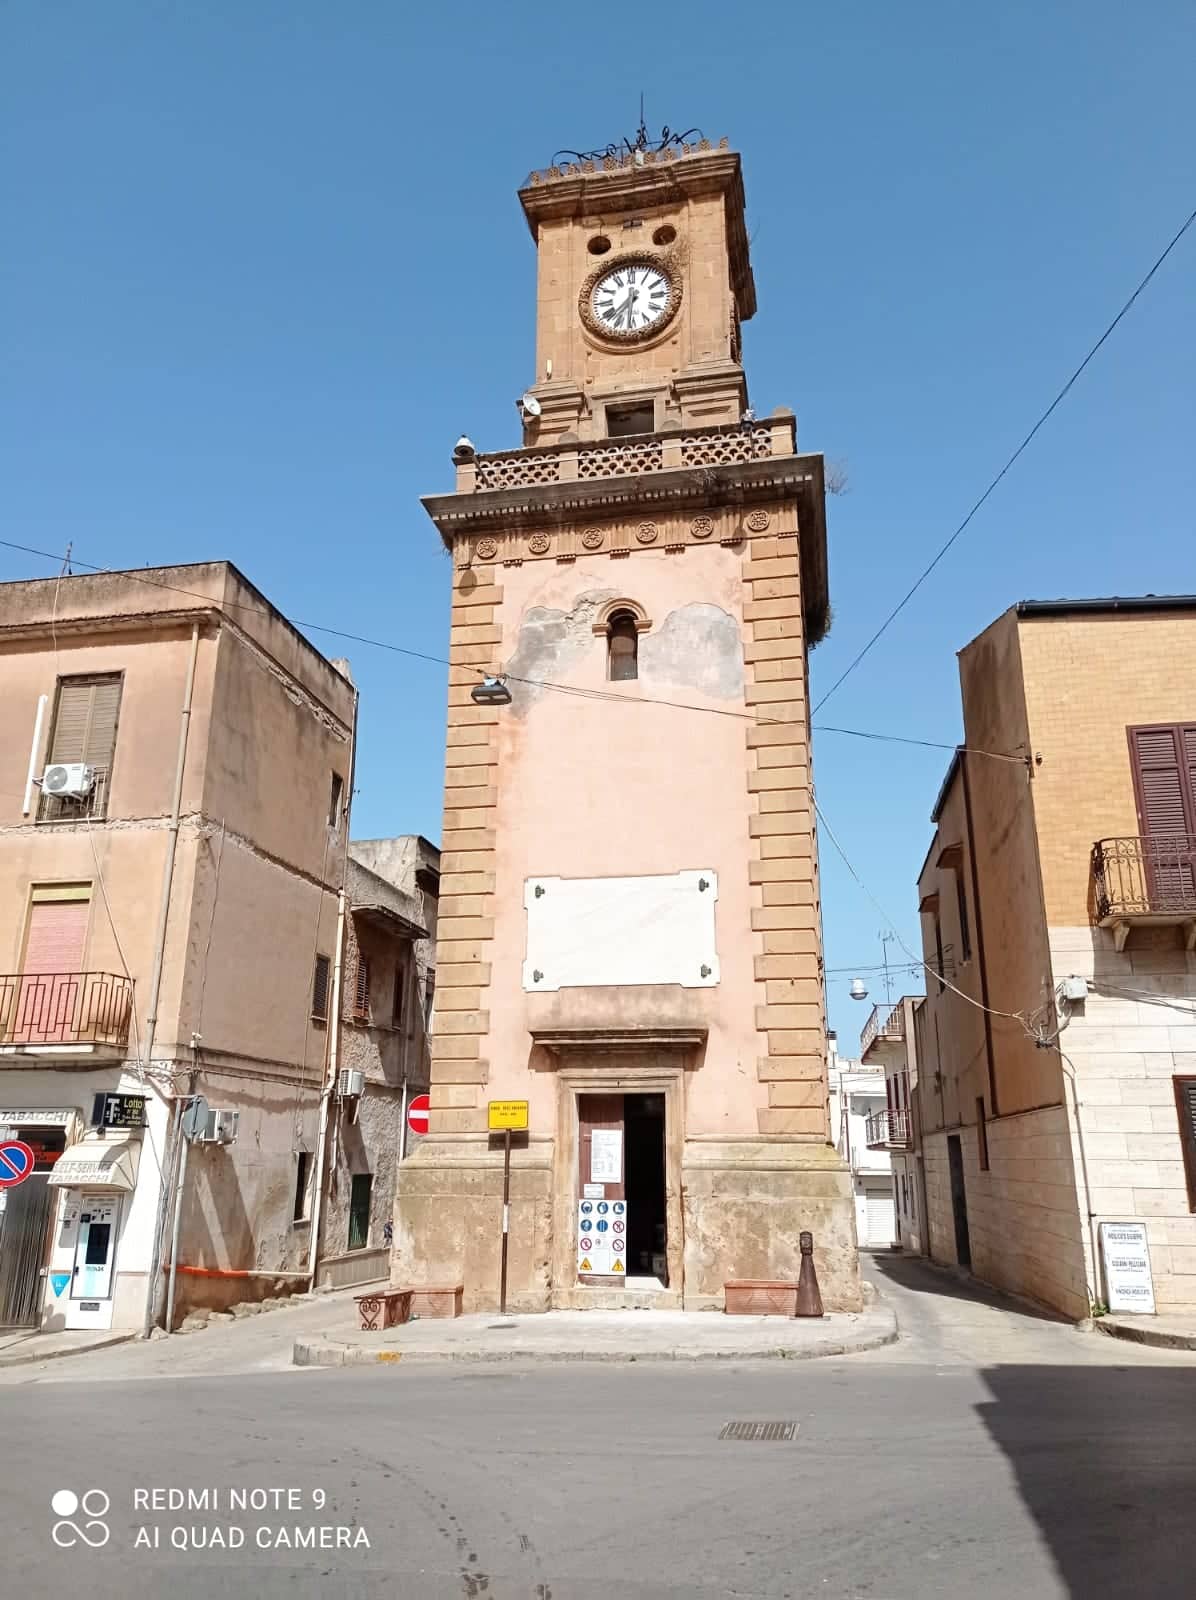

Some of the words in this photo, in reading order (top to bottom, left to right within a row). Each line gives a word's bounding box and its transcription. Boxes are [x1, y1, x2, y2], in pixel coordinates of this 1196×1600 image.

[626, 271, 636, 285] XII
[123, 1097, 143, 1109] Lotto
[2, 1111, 68, 1121] TABACCHI
[107, 1098, 121, 1123] T
[49, 1174, 110, 1183] TABACCHI
